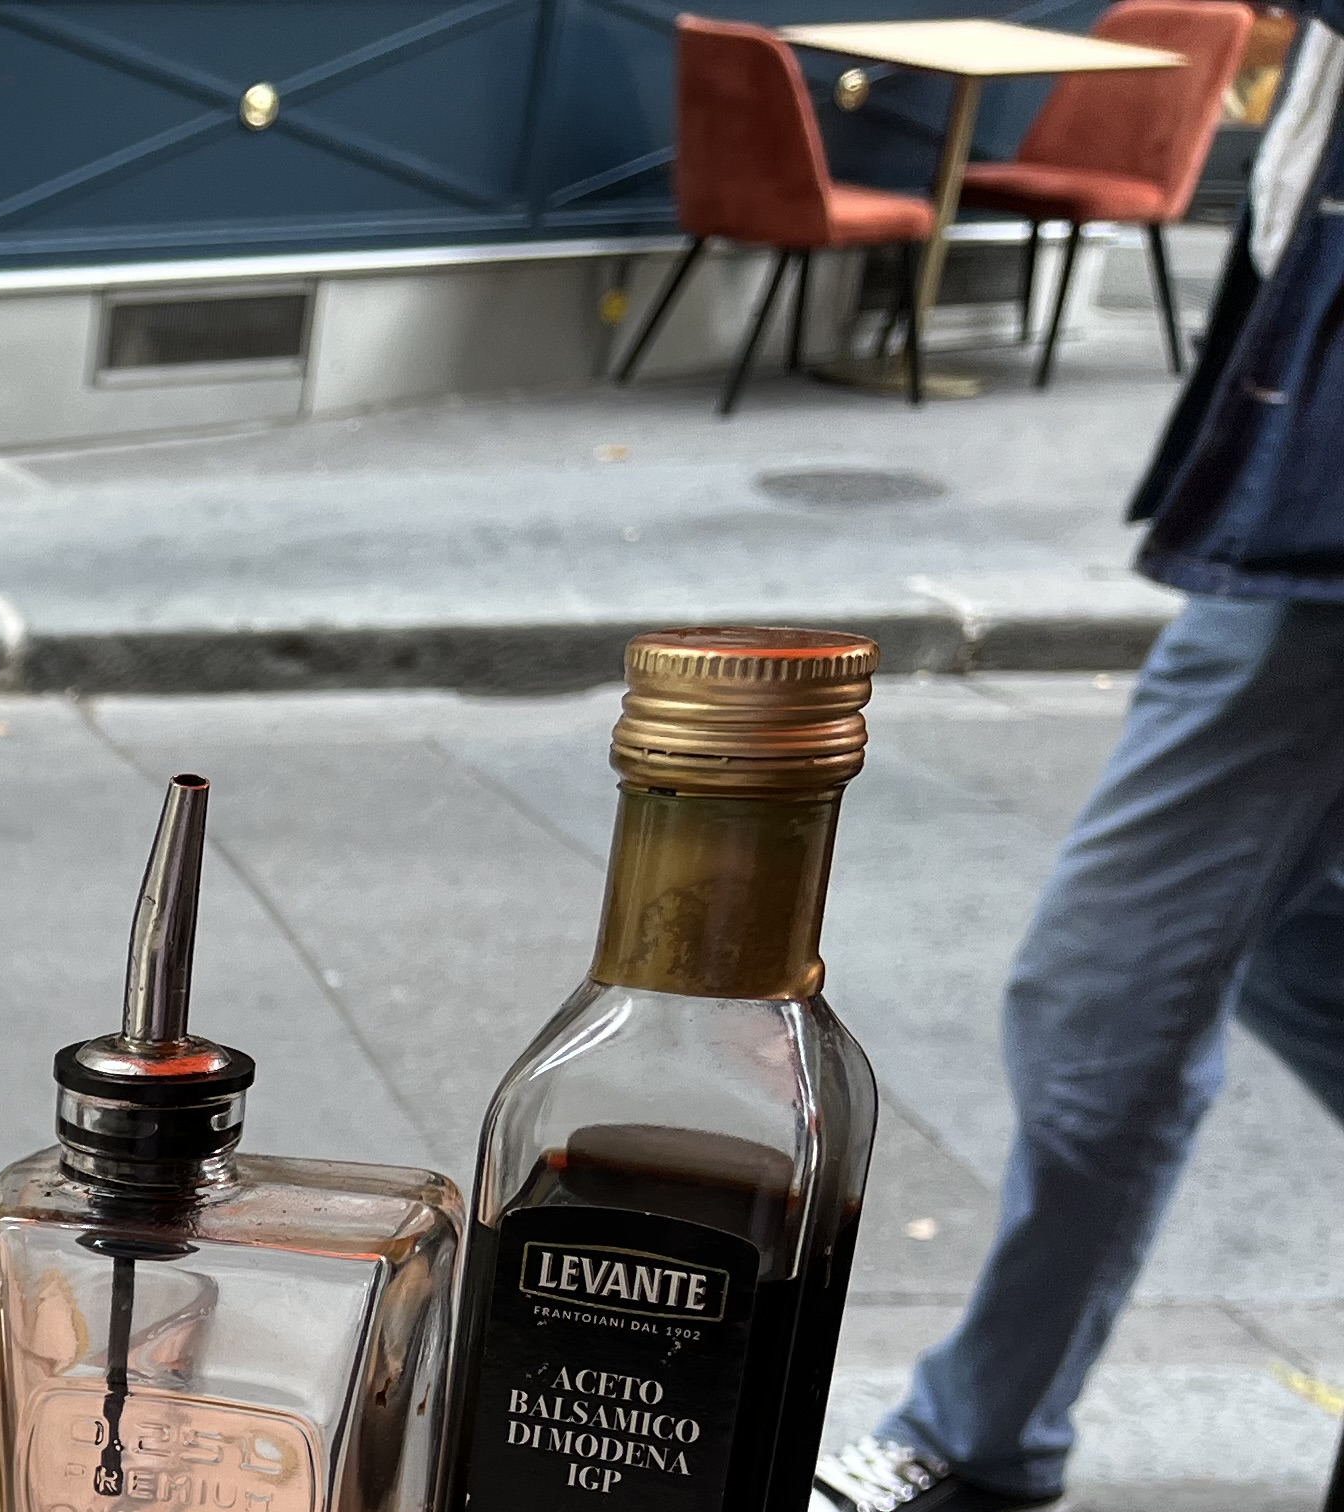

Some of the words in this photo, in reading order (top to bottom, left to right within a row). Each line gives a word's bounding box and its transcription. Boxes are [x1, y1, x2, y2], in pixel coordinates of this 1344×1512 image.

[537, 1251, 707, 1311] LEVANTE
[533, 1305, 625, 1328] FRANTOIANI
[630, 1321, 659, 1335] DAL
[665, 1327, 701, 1341] 1902
[550, 1366, 664, 1405] ACETO
[507, 1389, 700, 1444] BALSAMICO
[506, 1420, 543, 1449] DI
[545, 1427, 692, 1476] MODENA
[565, 1462, 622, 1494] IGP
